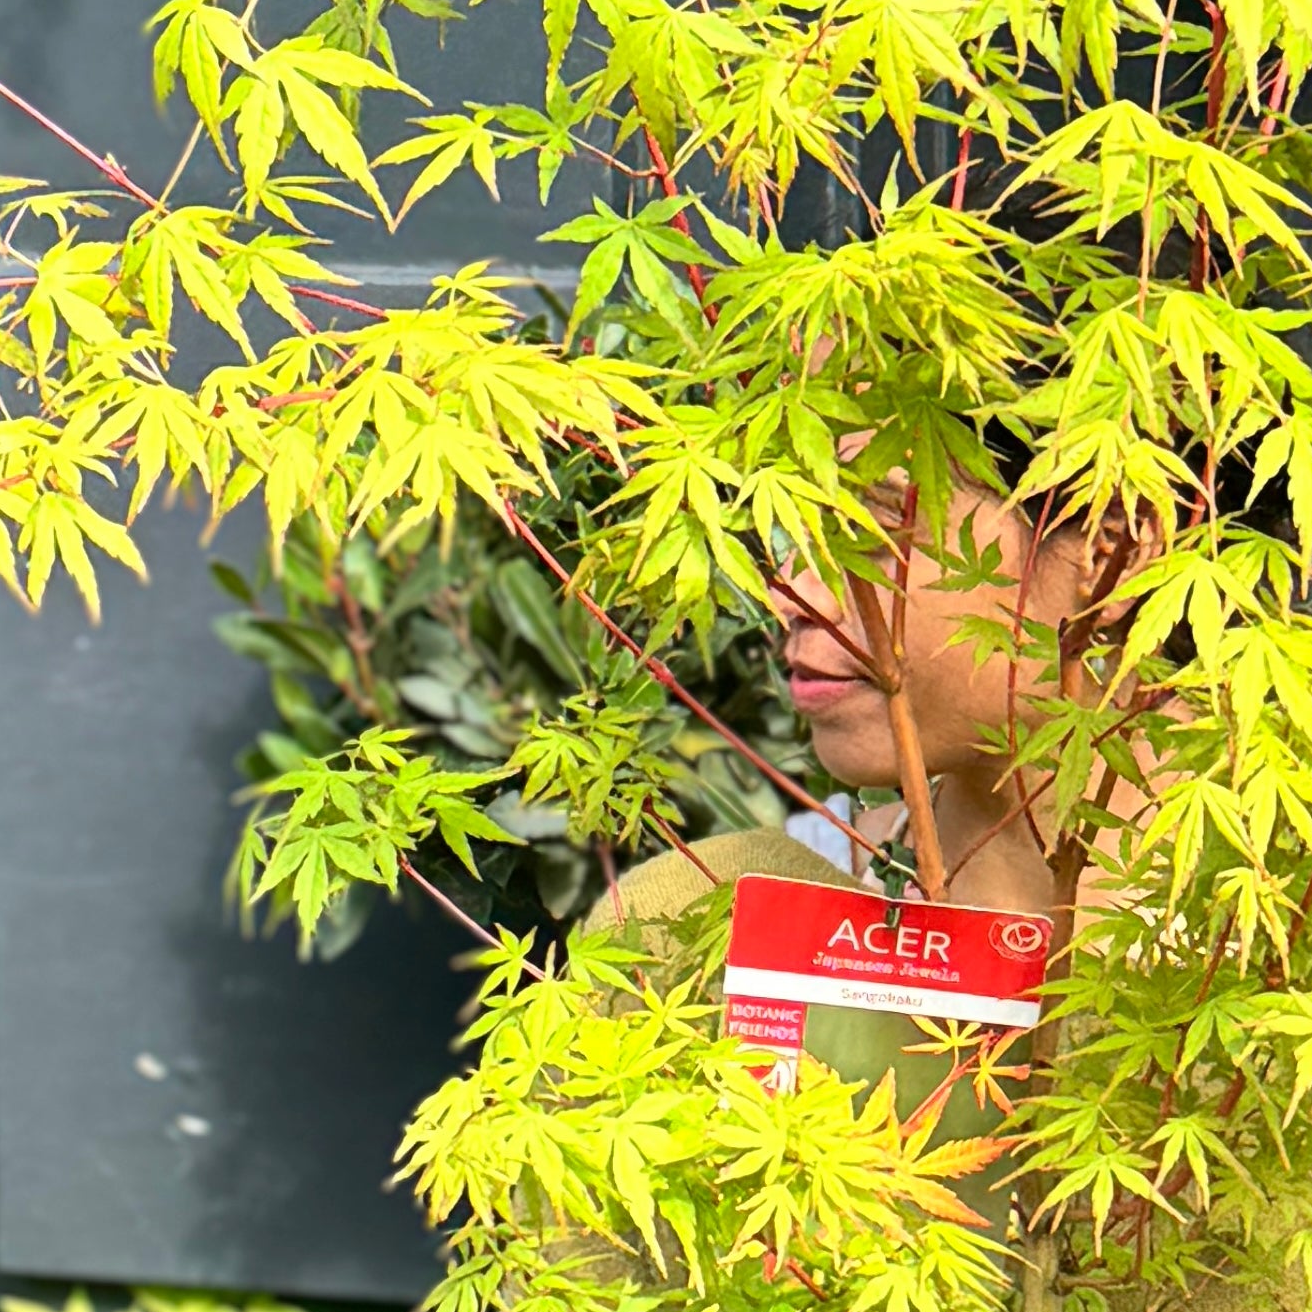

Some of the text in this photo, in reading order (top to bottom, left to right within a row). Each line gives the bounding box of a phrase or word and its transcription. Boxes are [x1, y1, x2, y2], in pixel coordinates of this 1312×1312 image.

[827, 918, 951, 963] ACER
[732, 1003, 802, 1023] BOTANIC
[729, 1020, 799, 1041] FRIENDS
